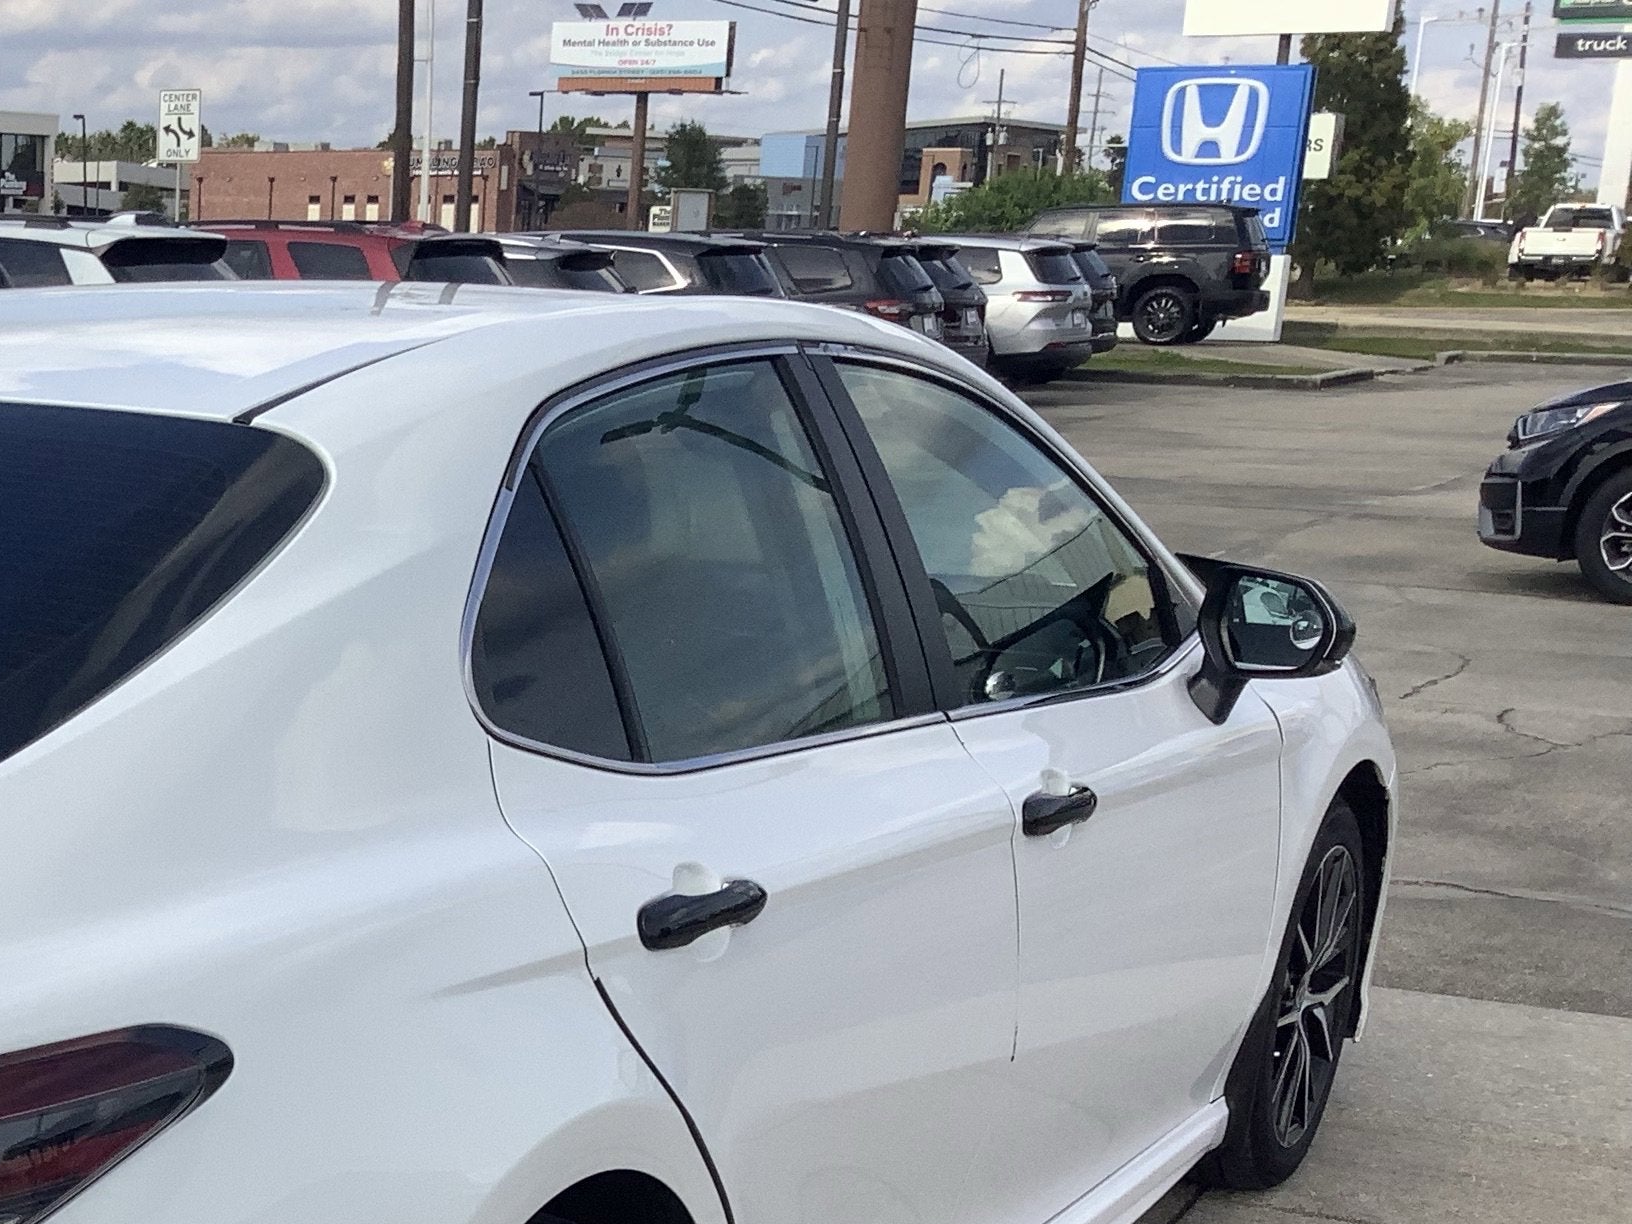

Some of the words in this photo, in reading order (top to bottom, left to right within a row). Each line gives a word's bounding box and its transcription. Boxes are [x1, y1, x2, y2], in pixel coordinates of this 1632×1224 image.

[605, 23, 619, 36] In
[624, 23, 674, 36] Crisis?
[562, 38, 596, 48] Mental
[597, 38, 630, 48] Health
[631, 40, 642, 48] or
[644, 38, 695, 48] Substance
[697, 38, 716, 48] Use
[1576, 35, 1628, 51] truck
[163, 93, 198, 103] CENTER
[167, 103, 192, 112] LANE
[166, 148, 191, 158] ONLY
[1130, 175, 1286, 201] Certified
